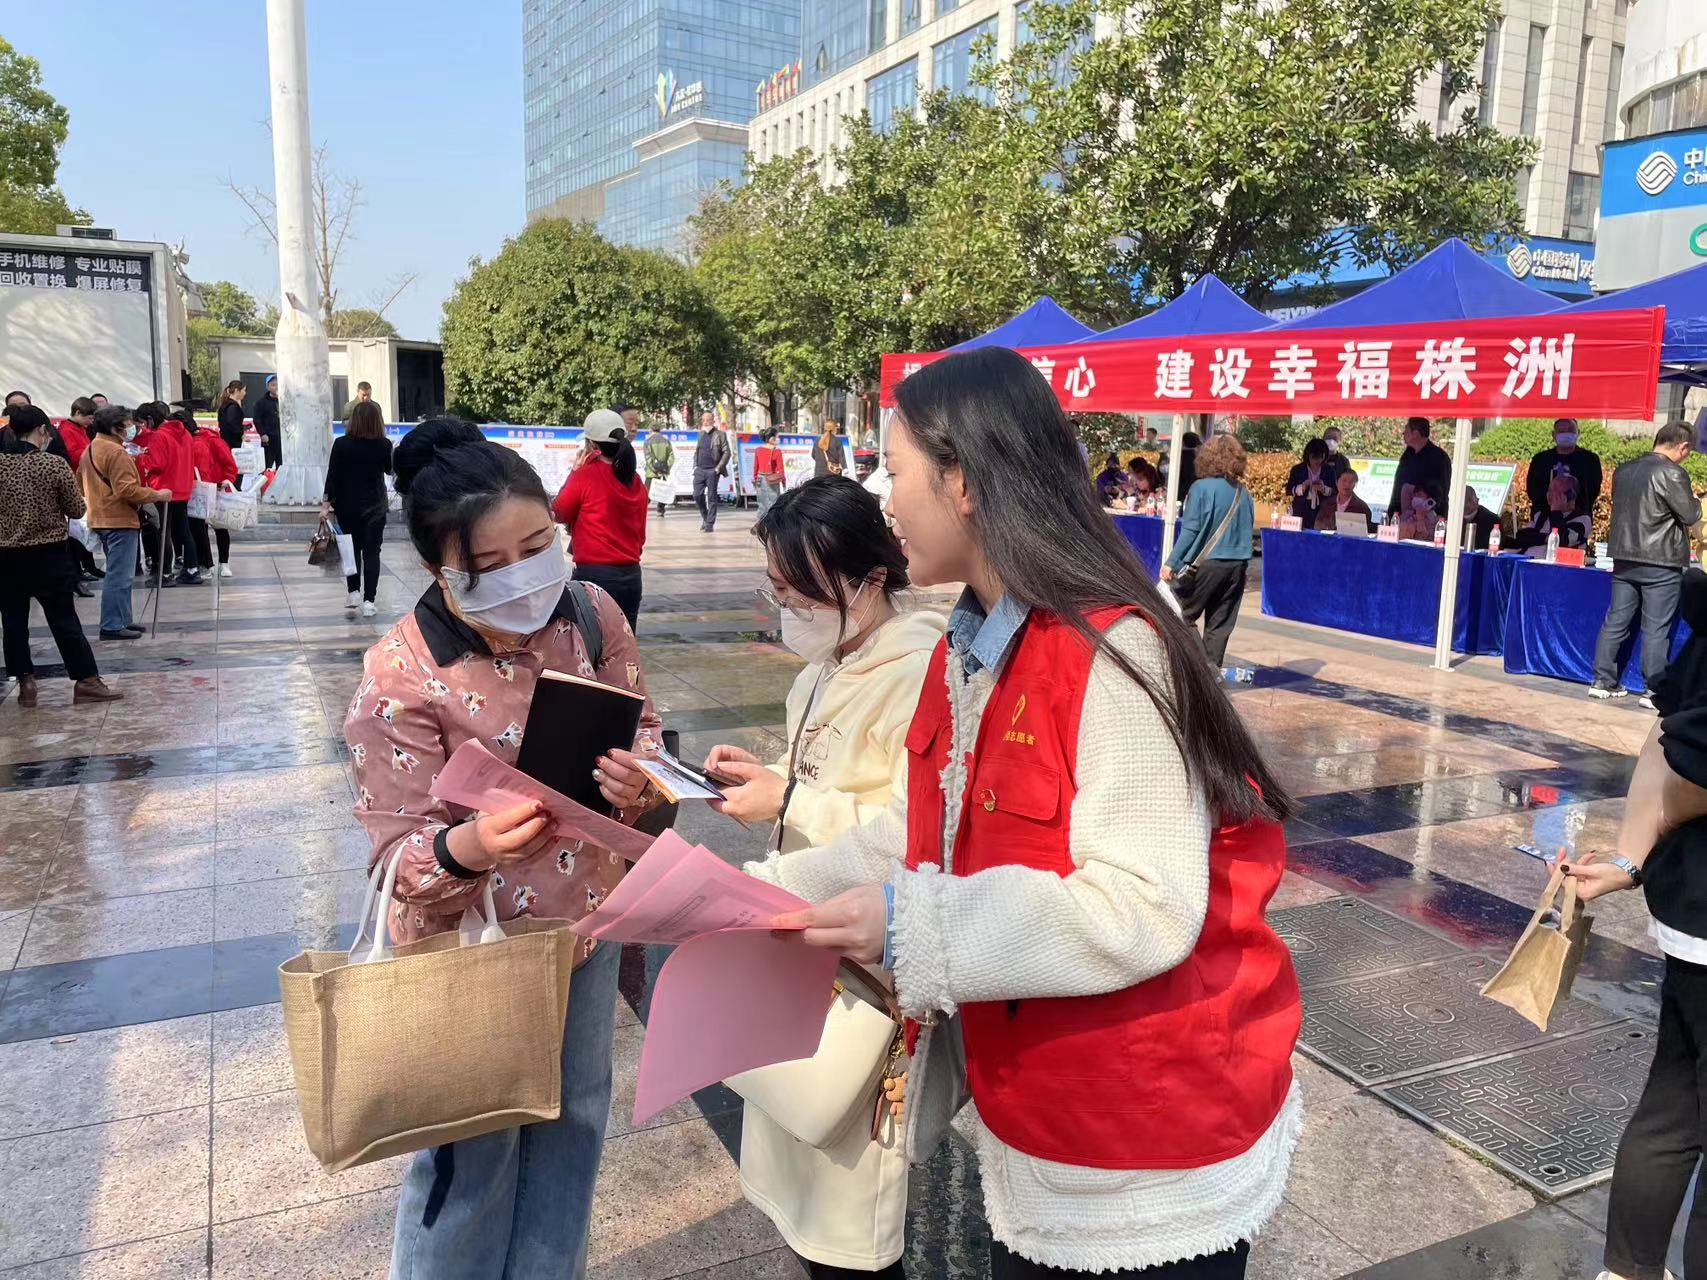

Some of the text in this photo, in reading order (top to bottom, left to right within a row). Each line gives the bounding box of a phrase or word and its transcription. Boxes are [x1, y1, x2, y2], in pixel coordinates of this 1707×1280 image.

[1684, 148, 1707, 169] 中
[1683, 170, 1707, 185] Chi
[0, 252, 142, 275] 手机维修 专业贴膜
[0, 271, 67, 289] 回收置换
[1154, 333, 1575, 400] 建设幸福株洲
